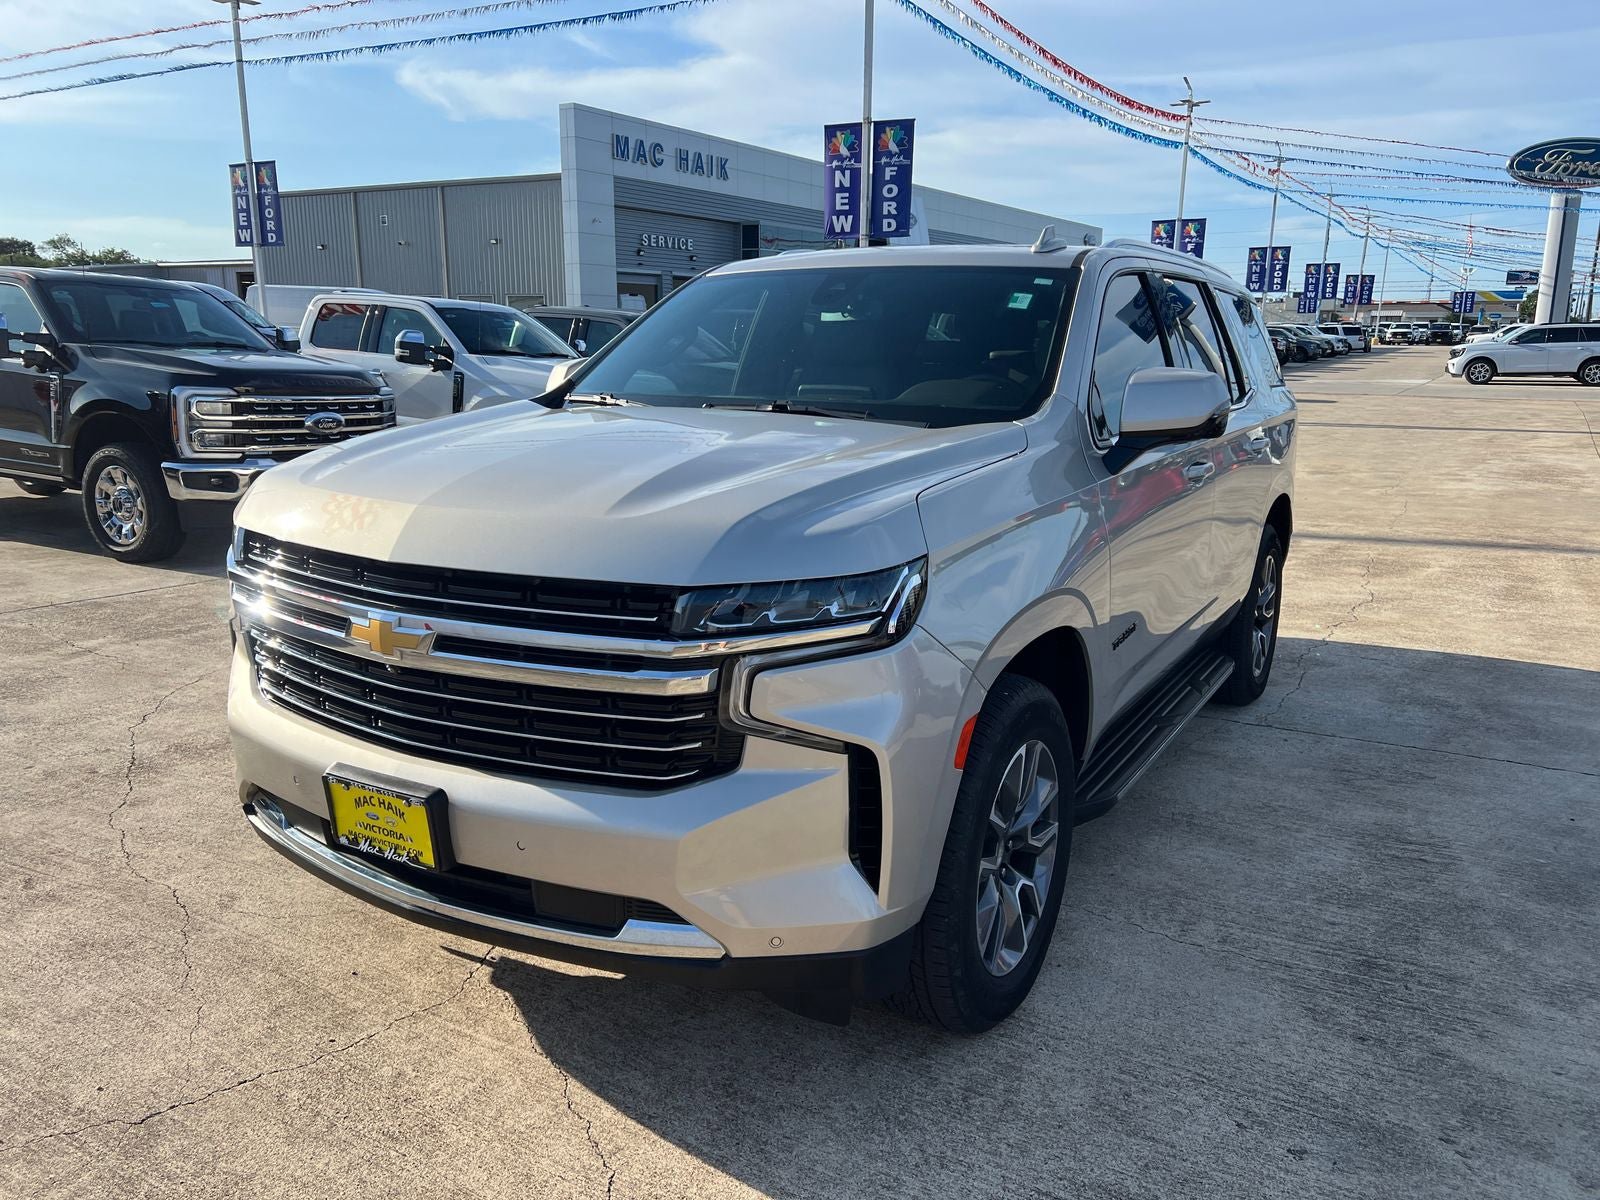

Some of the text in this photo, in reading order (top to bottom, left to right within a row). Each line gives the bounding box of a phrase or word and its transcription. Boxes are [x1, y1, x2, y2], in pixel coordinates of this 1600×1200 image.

[612, 133, 729, 181] MAC HAIK
[832, 170, 853, 232] NEW
[882, 166, 899, 232] FORD
[237, 196, 251, 243] NEW
[264, 195, 277, 243] FORD
[641, 233, 695, 251] SERVICE
[1249, 264, 1261, 291] NEW
[1273, 263, 1283, 291] FORD
[1306, 277, 1316, 298] NEW
[1325, 277, 1334, 298] FORD
[354, 796, 376, 809] MAC
[378, 797, 406, 823] HAIK
[362, 822, 405, 842] VICTORIA
